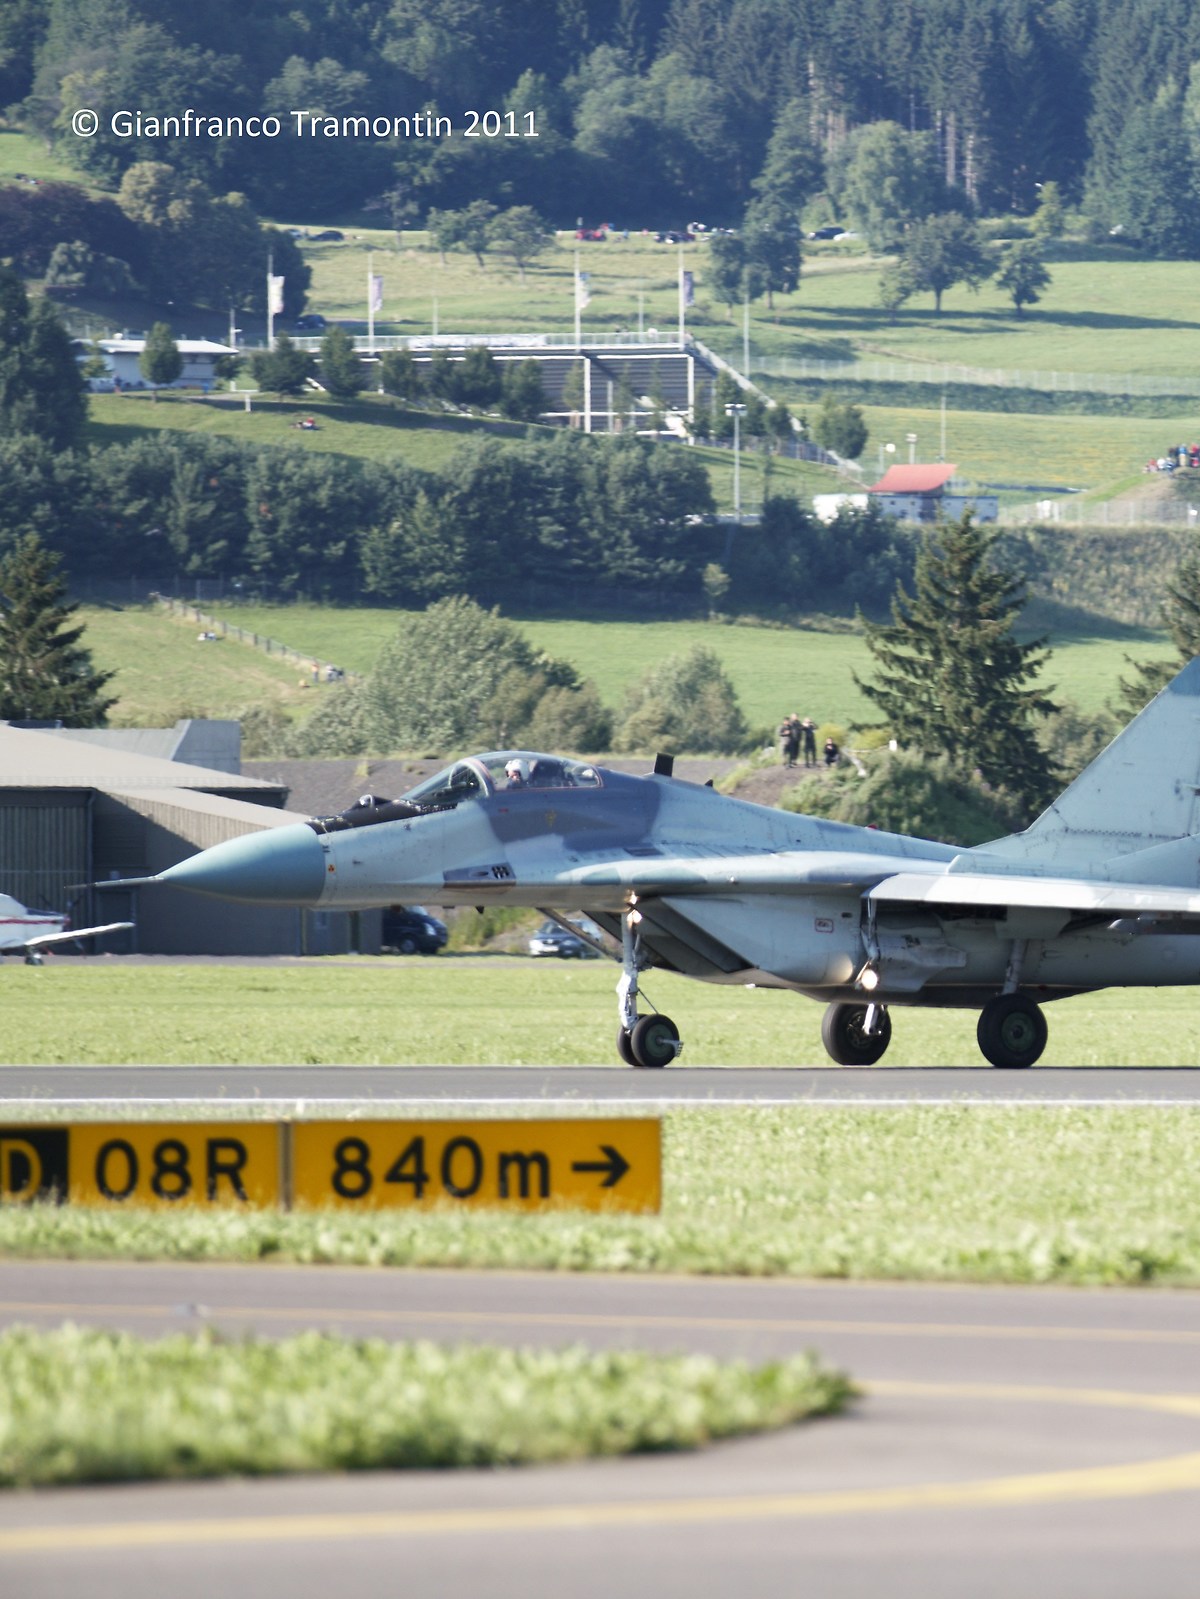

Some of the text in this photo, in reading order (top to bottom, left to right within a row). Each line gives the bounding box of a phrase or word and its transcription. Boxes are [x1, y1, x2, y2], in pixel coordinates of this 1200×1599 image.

[1, 1135, 551, 1201] D 08R 840m
